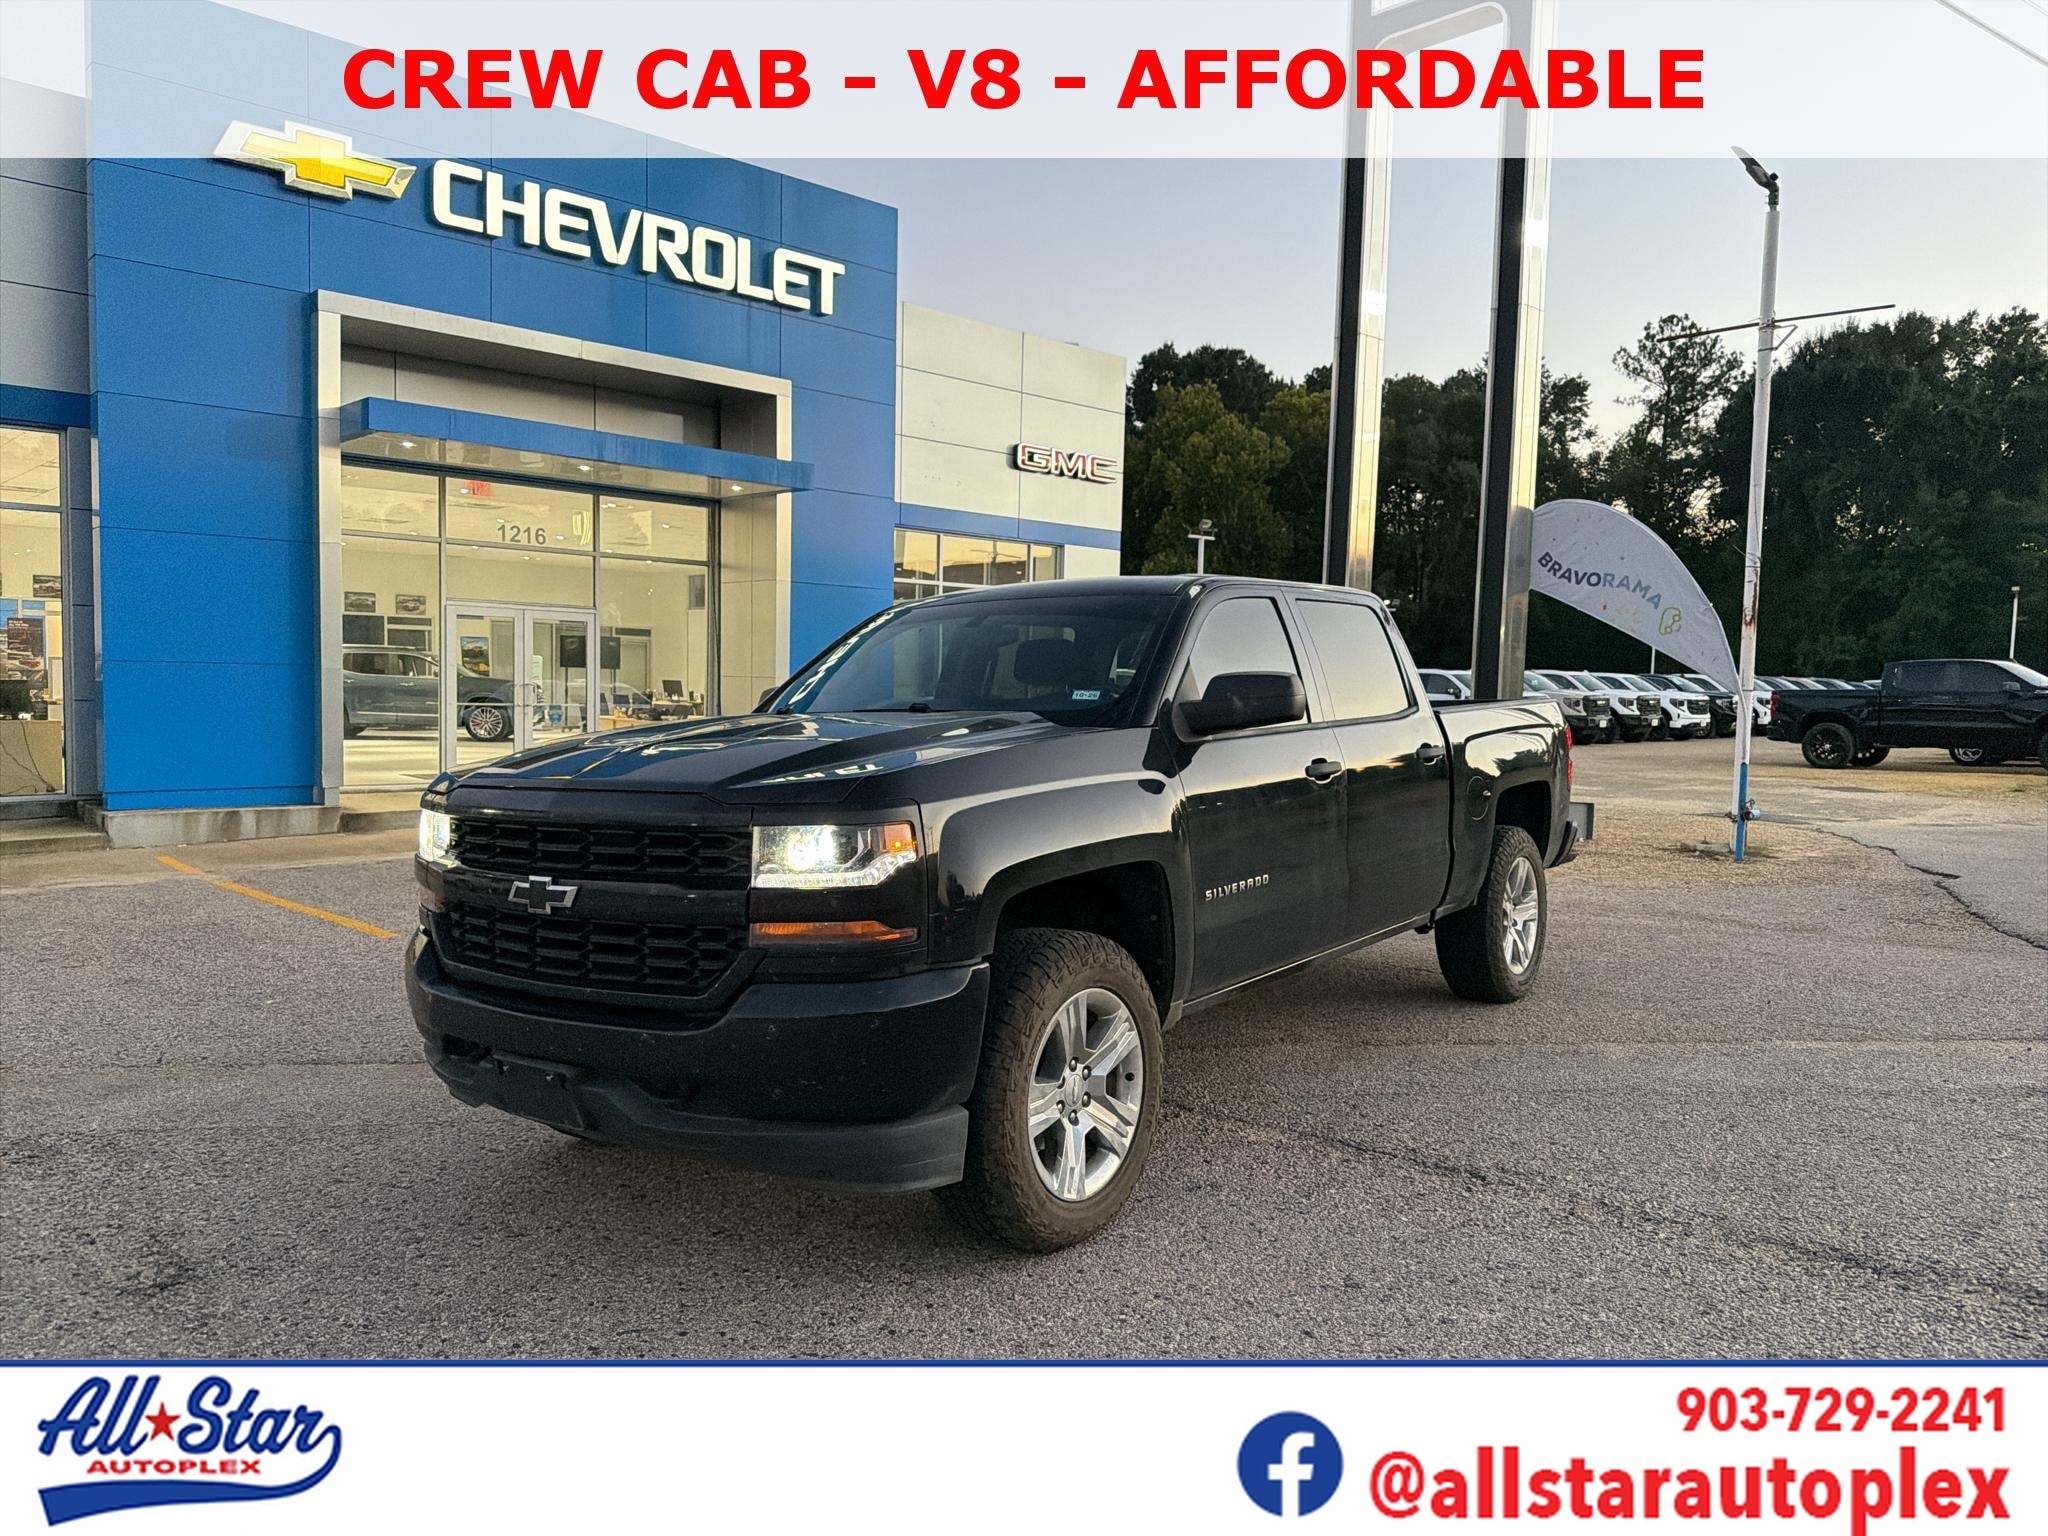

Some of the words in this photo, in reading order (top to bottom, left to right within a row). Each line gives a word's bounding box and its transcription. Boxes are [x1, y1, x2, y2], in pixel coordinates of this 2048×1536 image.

[431, 159, 846, 316] CHEVROLET
[1015, 442, 1118, 483] GMC
[497, 524, 546, 545] 1216
[1537, 551, 1663, 610] BRAVORAMA
[1205, 874, 1269, 902] SILVERADO
